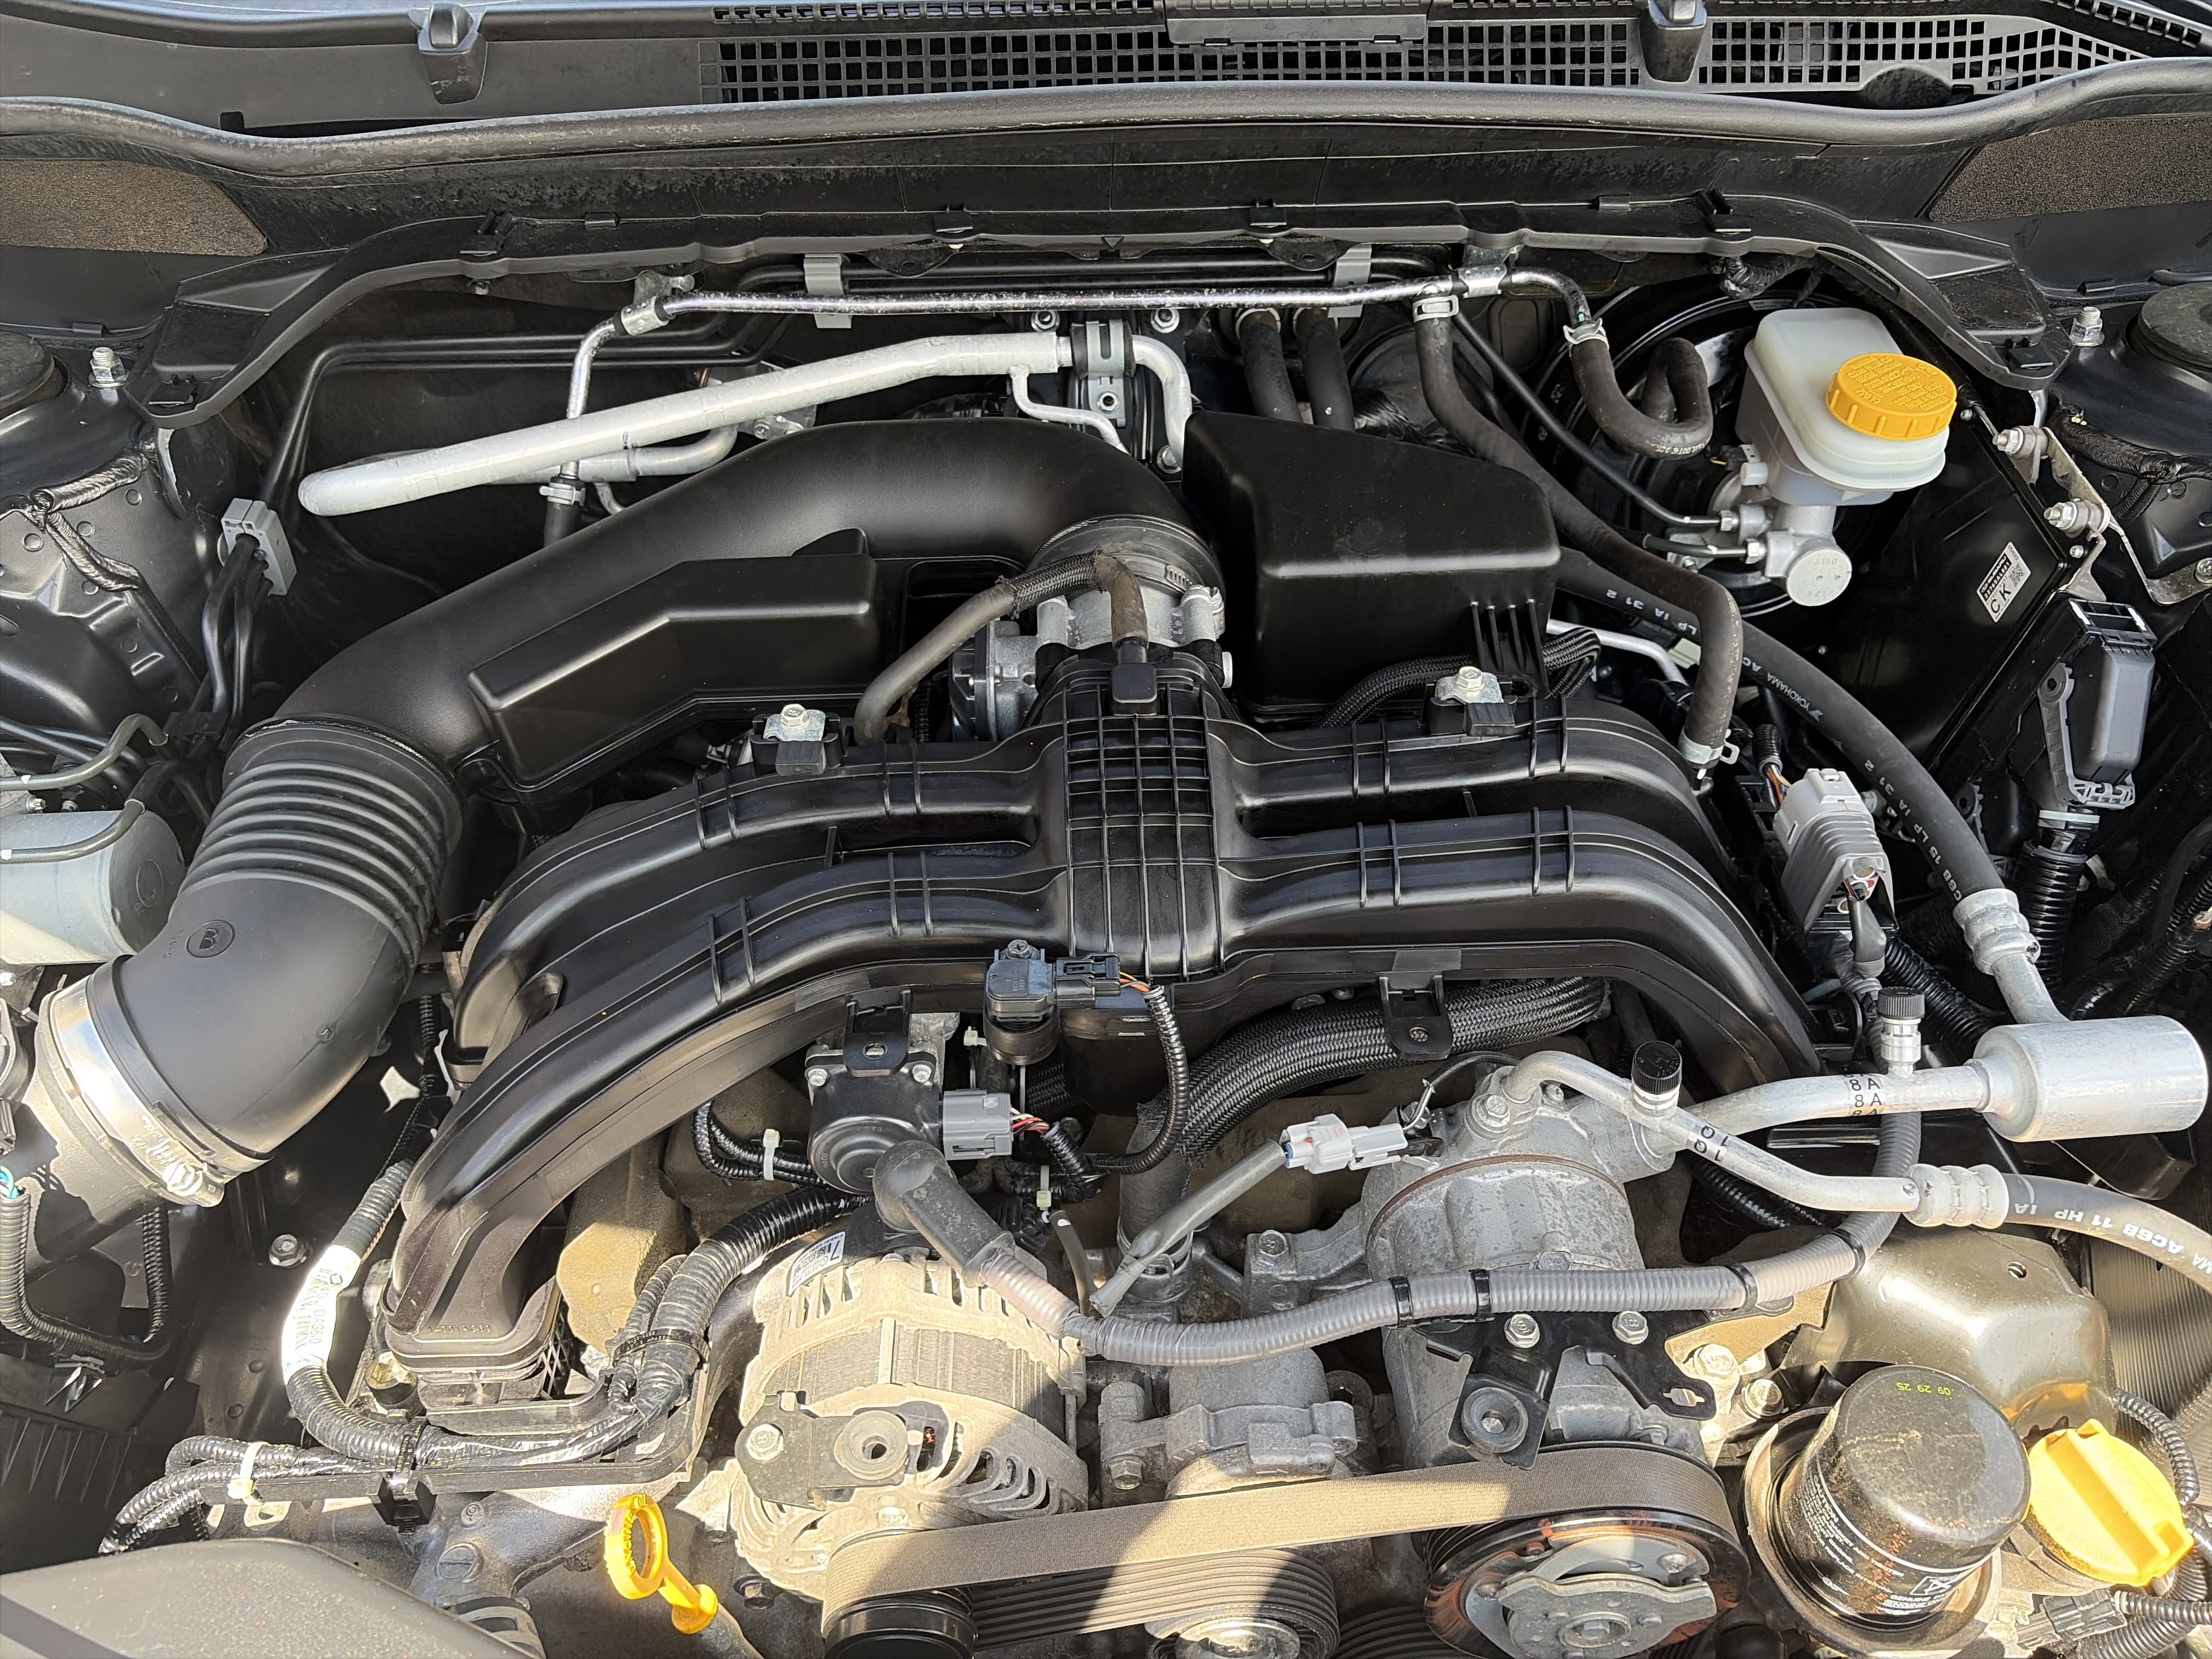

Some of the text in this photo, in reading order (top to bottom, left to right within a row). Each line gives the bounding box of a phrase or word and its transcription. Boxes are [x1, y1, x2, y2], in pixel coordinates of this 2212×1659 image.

[1918, 363, 1939, 375] OPEN
[1855, 388, 1881, 404] CLOSE
[2007, 544, 2019, 561] DENSO
[1605, 587, 1618, 600] 2
[1625, 595, 1645, 610] 31
[1676, 618, 1699, 637] LP
[1764, 670, 1813, 712] YOKOHAMA
[1863, 759, 1876, 772] 2
[1877, 776, 1896, 795] 31
[1912, 821, 1931, 844] LP
[1927, 844, 1944, 865] 15
[1942, 867, 1964, 902] C6B
[199, 928, 217, 950] B
[2053, 1206, 2084, 1223] HP
[2091, 1214, 2114, 1229] 11
[2122, 1223, 2185, 1255] AC6B
[1897, 1382, 1951, 1396] 09 29 25
[1813, 1474, 1839, 1523] CAUTION
[623, 1509, 638, 1577] ENGINE
[1829, 1520, 1854, 1548] GASKET
[1852, 1546, 1871, 1561] AND
[1813, 1530, 1826, 1547] FOR
[1824, 1544, 1856, 1576] REPLACE
